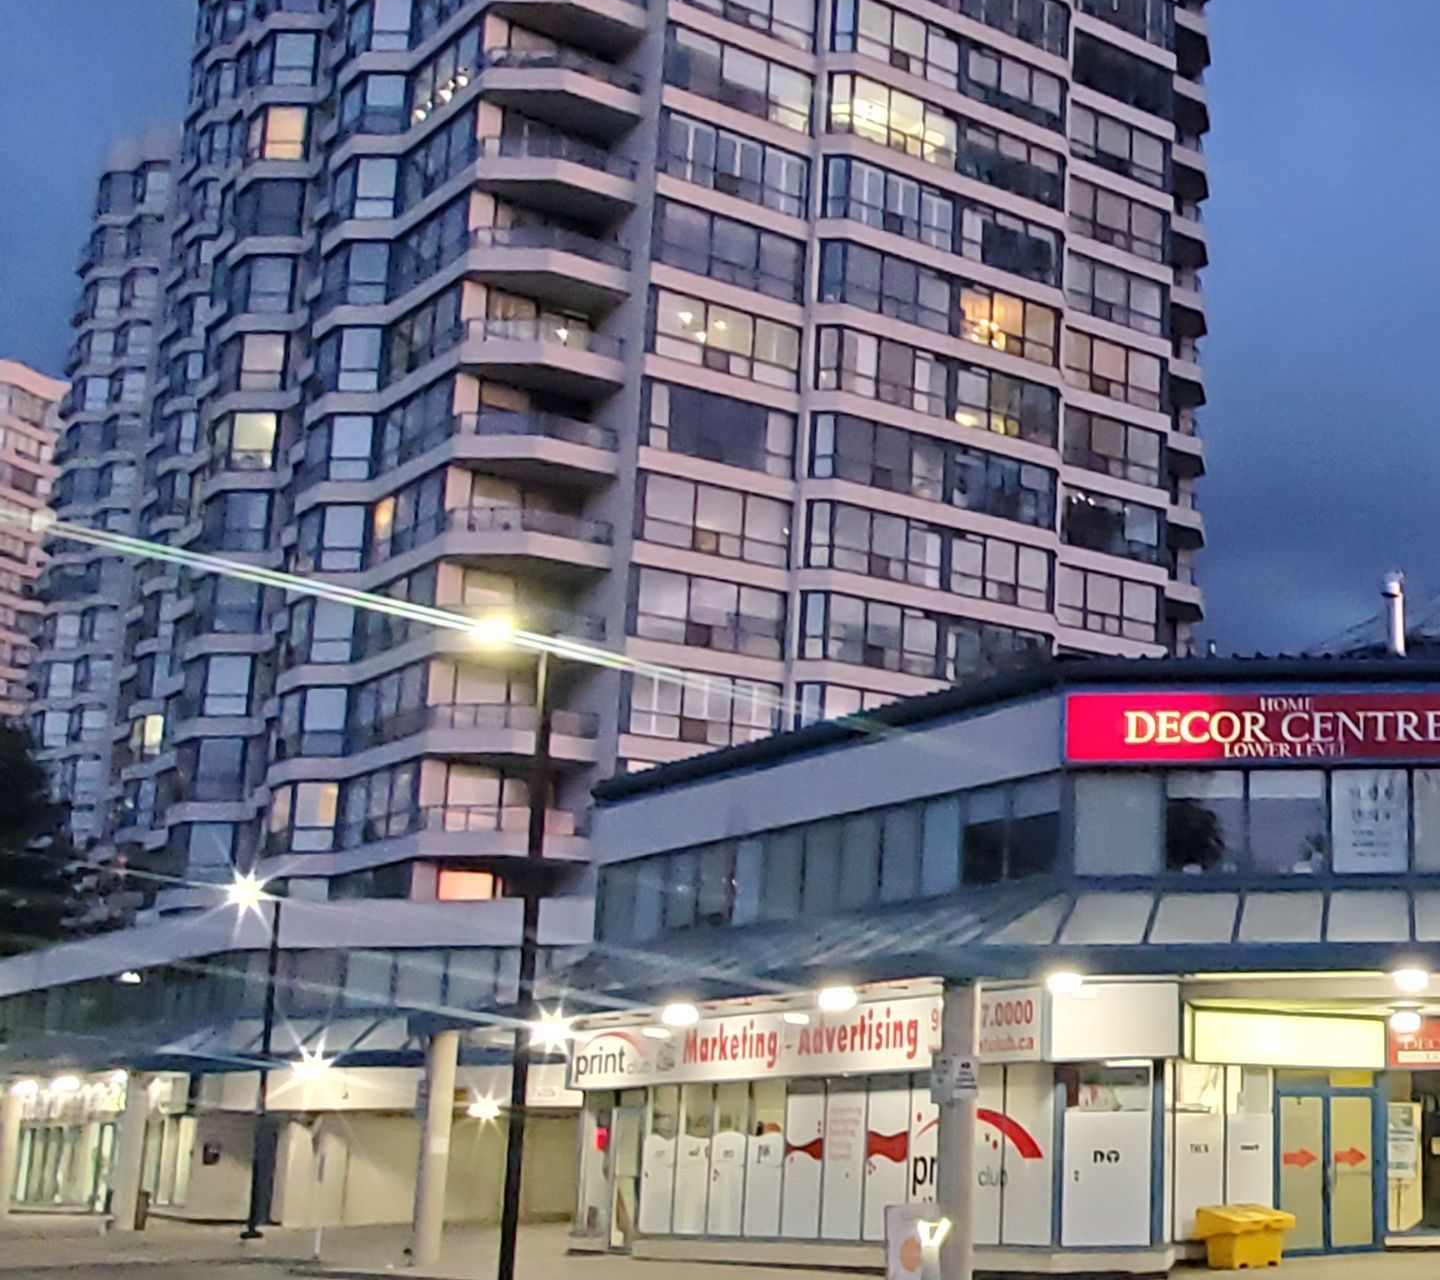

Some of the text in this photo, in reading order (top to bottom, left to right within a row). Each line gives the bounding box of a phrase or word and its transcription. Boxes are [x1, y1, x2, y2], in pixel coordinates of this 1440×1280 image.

[1124, 710, 1267, 744] DECOR
[1223, 741, 1292, 759] LOWER
[683, 1020, 778, 1069] Marketing
[575, 1045, 627, 1083] print
